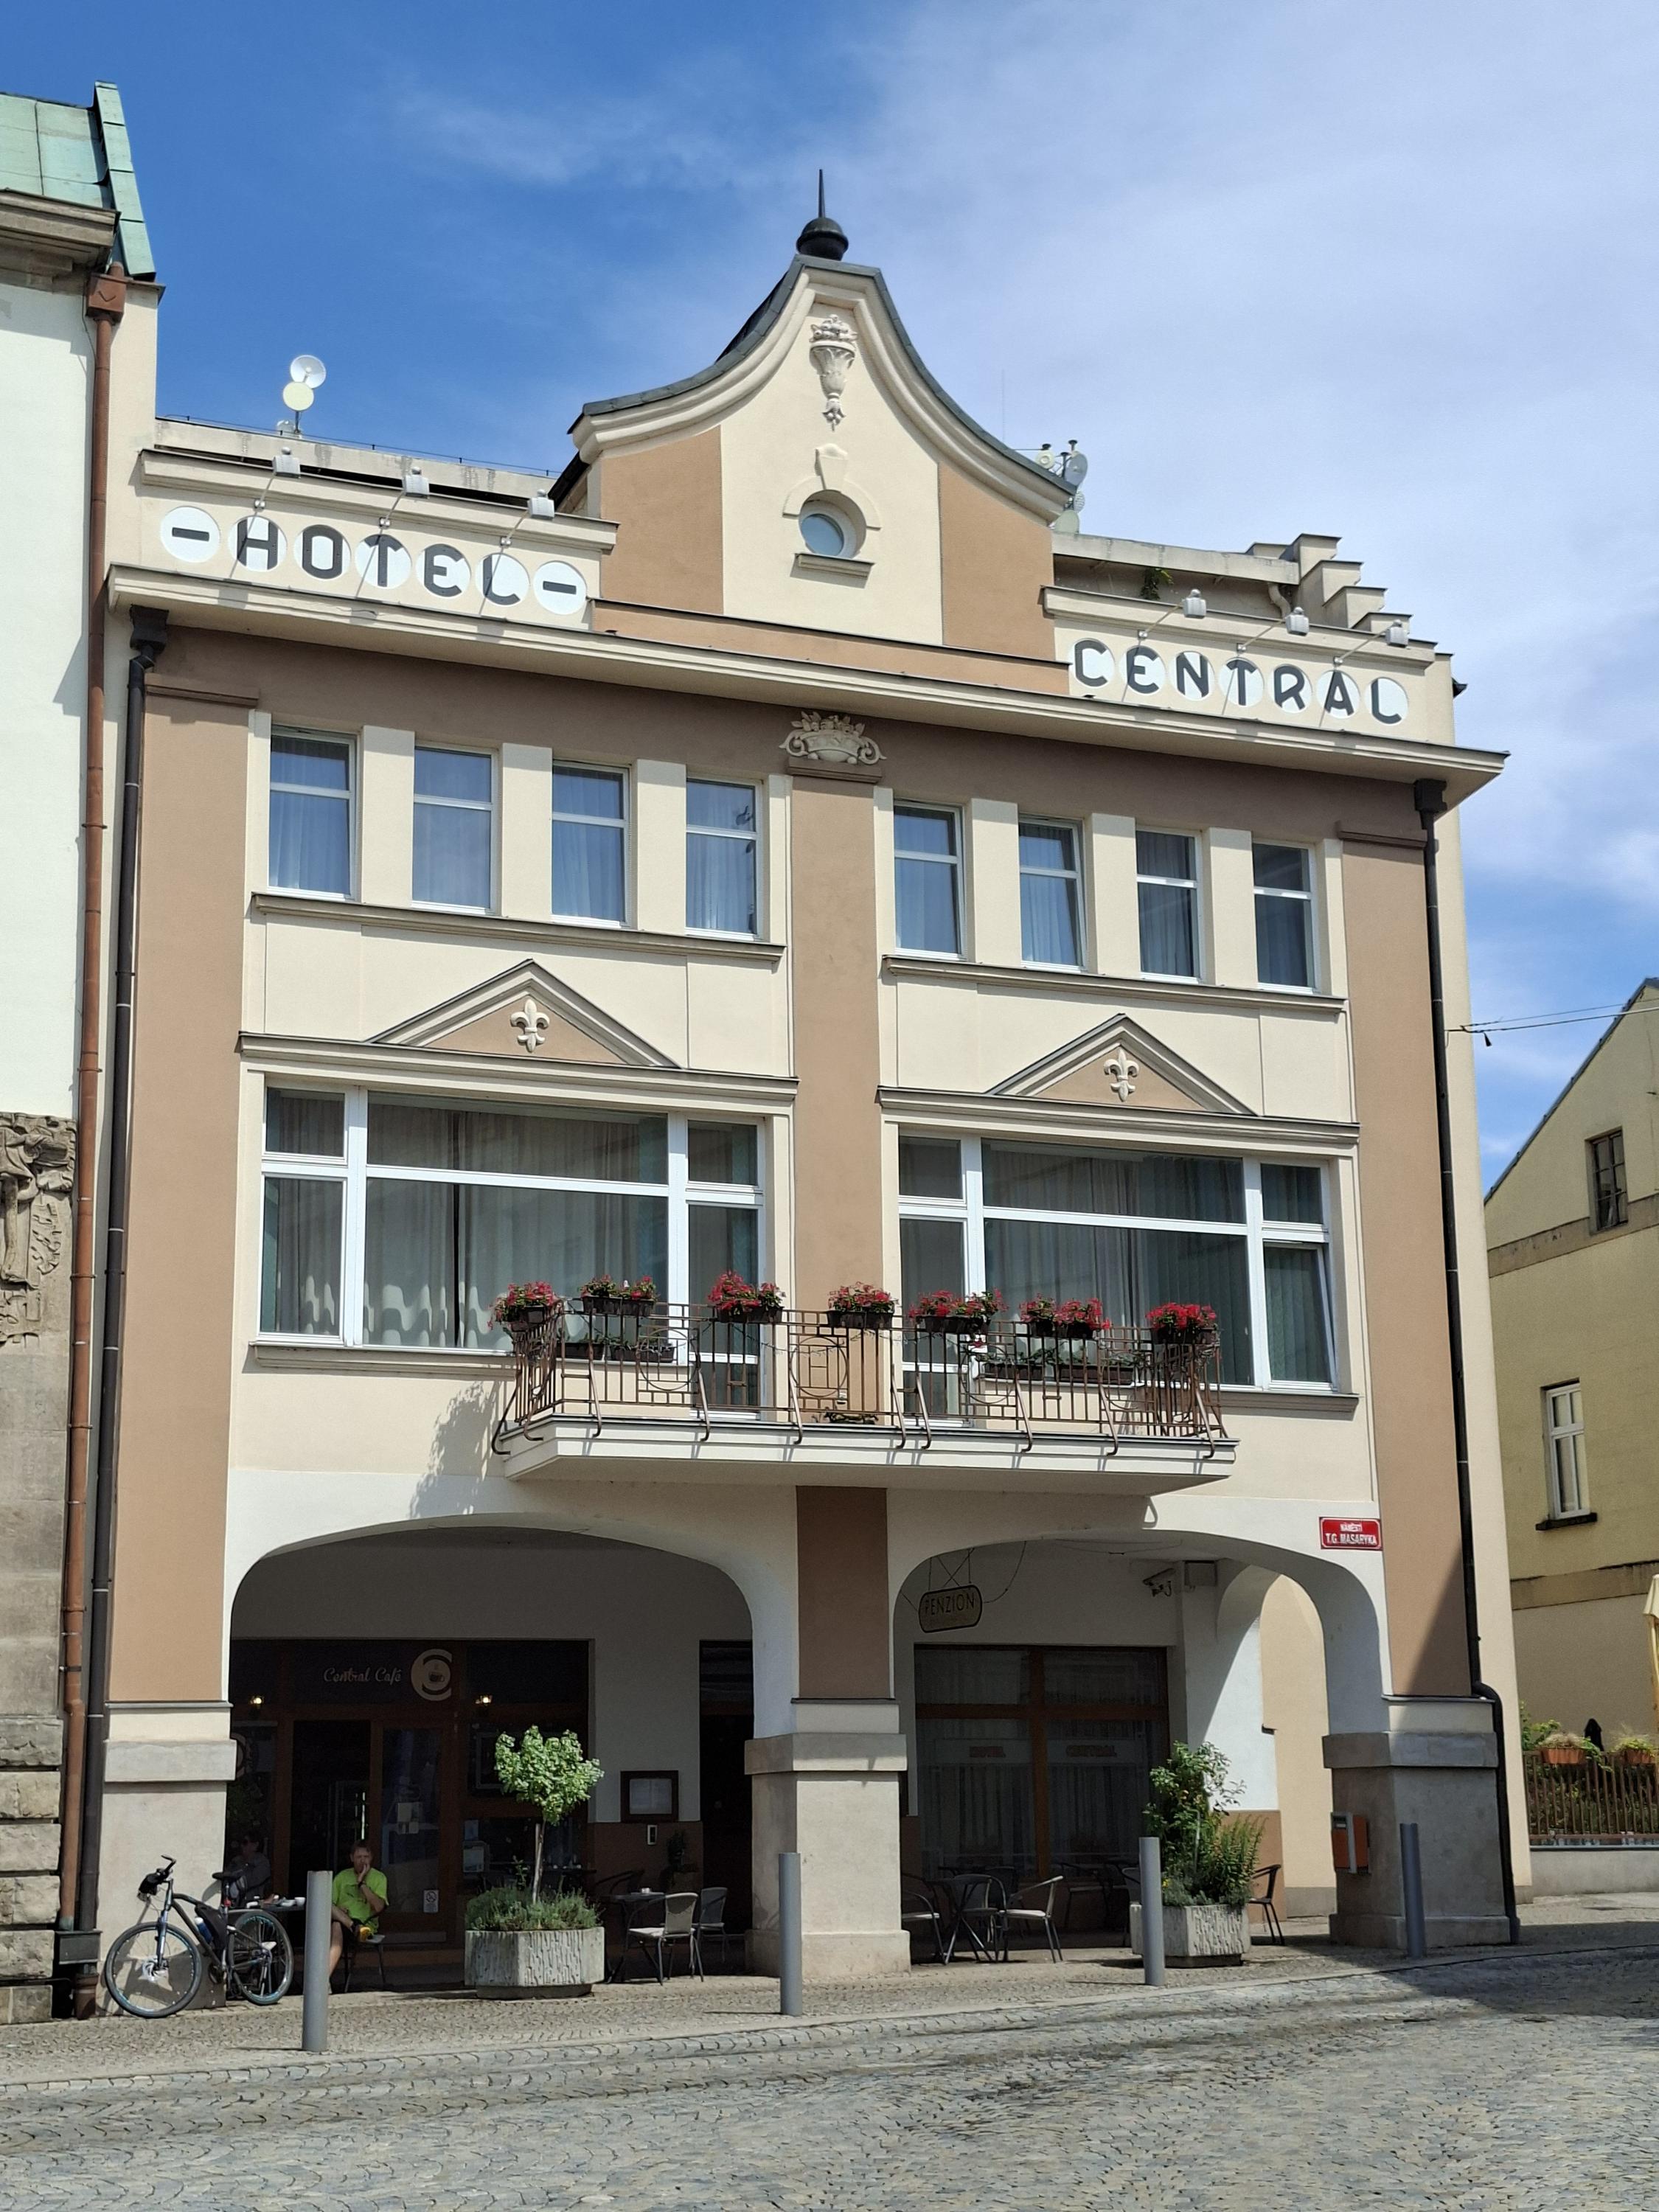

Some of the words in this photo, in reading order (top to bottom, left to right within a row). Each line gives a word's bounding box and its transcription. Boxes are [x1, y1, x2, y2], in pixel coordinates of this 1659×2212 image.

[1074, 639, 1402, 725] CENTRAL
[323, 1666, 371, 1683] Central
[375, 1666, 402, 1686] Café
